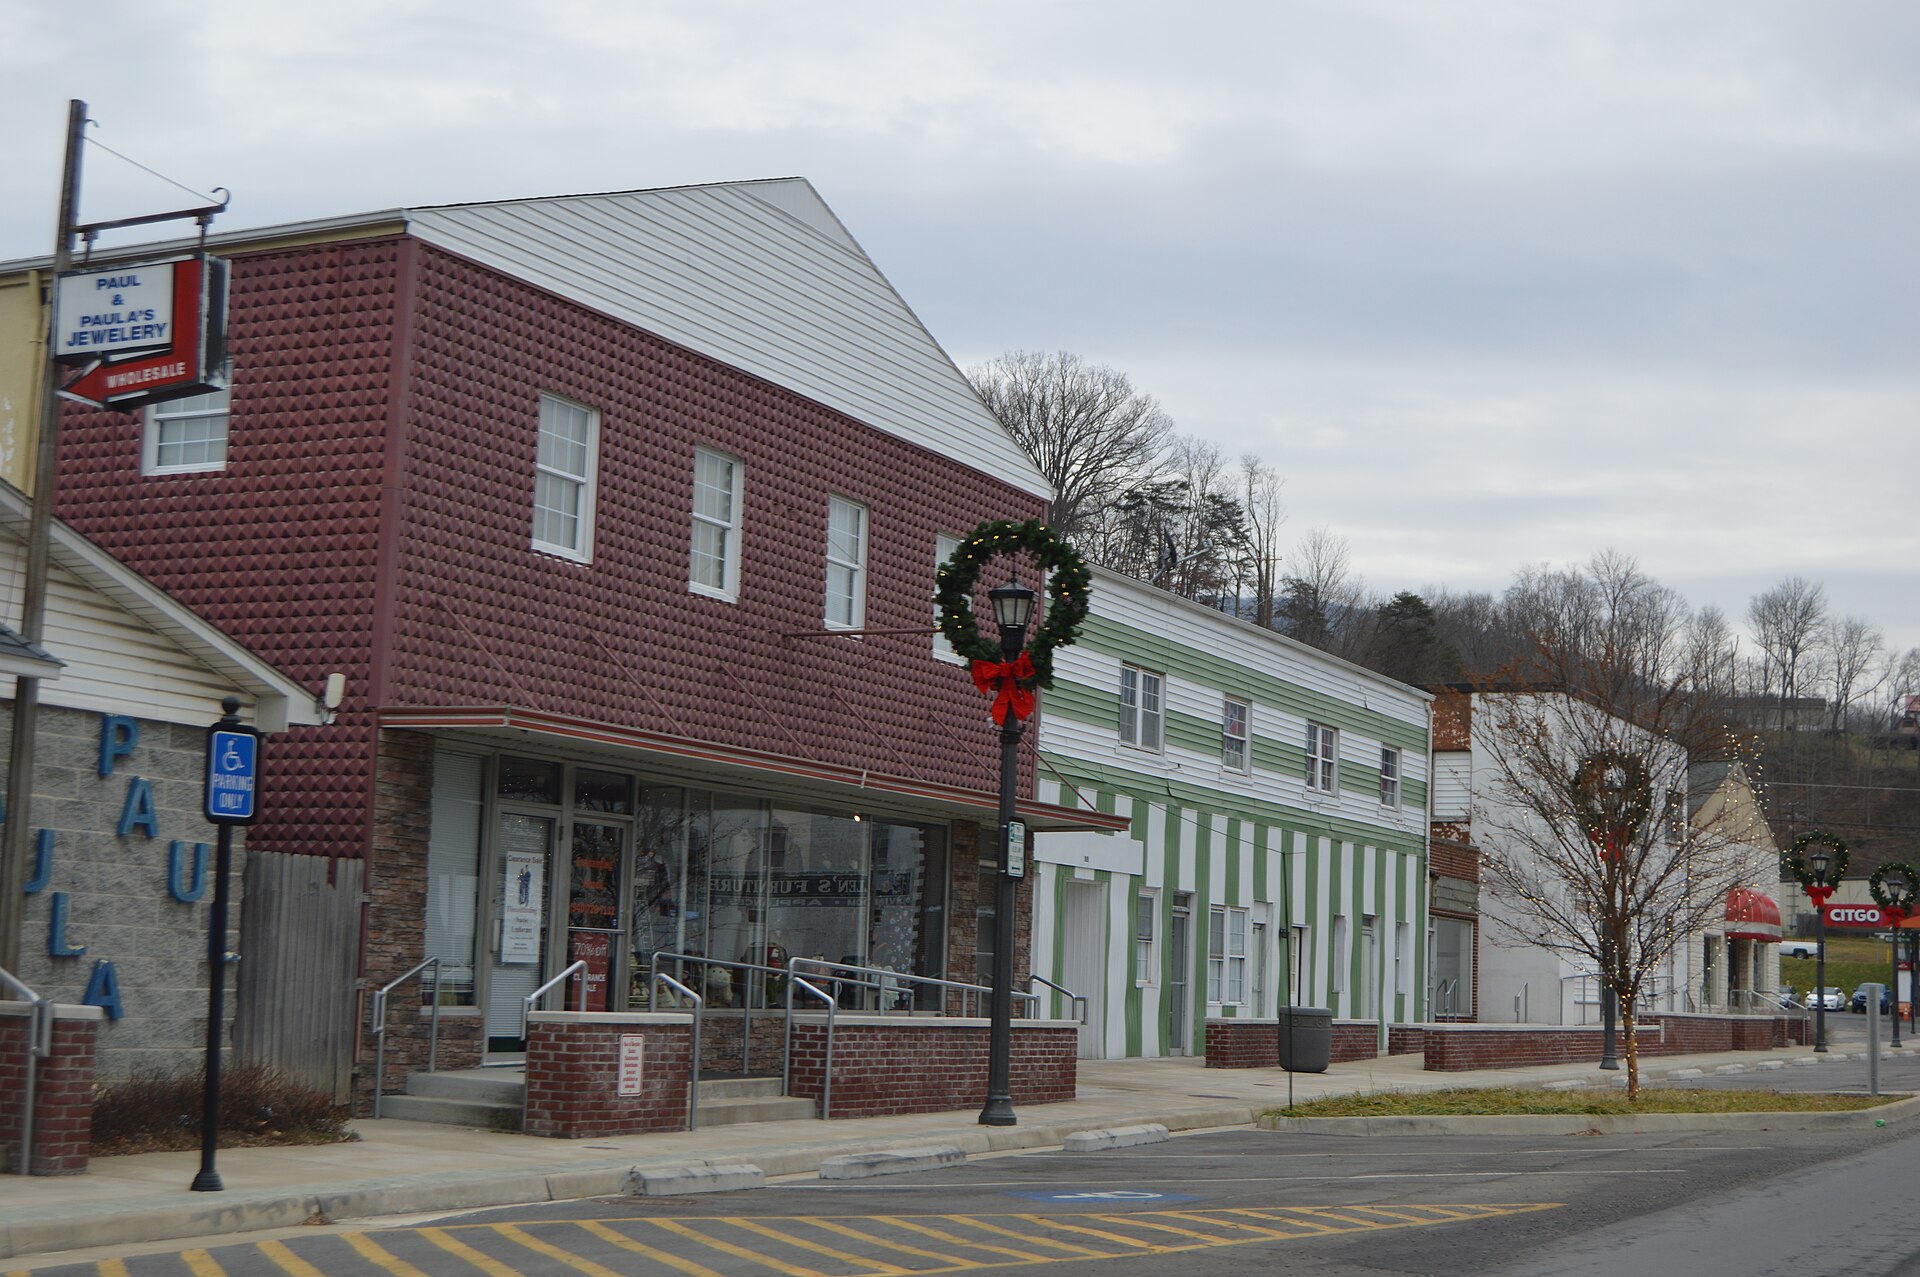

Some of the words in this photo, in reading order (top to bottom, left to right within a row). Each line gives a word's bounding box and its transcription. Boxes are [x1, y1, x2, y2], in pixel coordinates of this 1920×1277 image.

[96, 275, 141, 290] PAUL
[111, 294, 125, 306] &
[81, 309, 155, 327] PAULA'S
[66, 323, 168, 346] JEWELERY
[106, 362, 186, 388] WHOLESALE
[213, 773, 253, 791] PARKING
[219, 793, 244, 809] ONLY
[1830, 909, 1880, 923] CITGO
[573, 973, 606, 982] CLRANCE
